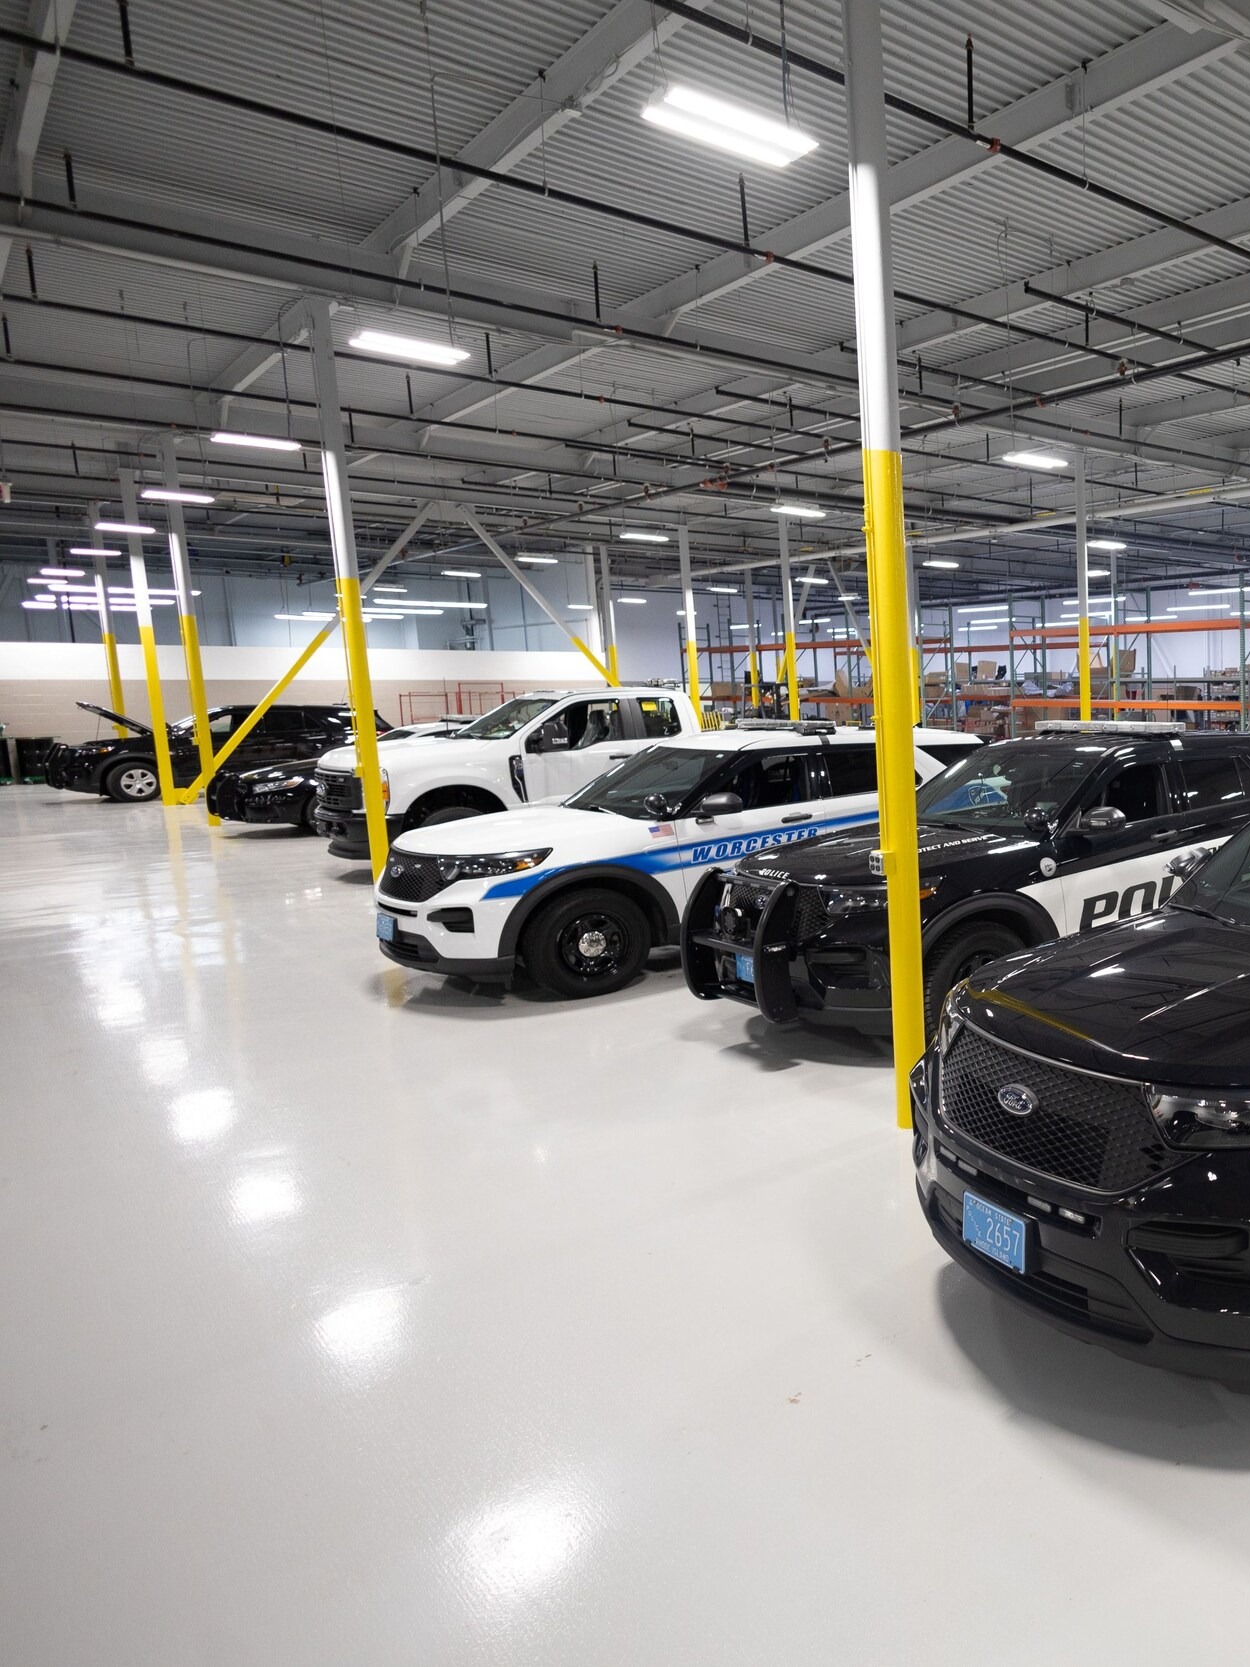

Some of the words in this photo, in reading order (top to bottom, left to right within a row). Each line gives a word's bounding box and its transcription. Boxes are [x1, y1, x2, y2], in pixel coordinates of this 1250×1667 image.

[690, 826, 820, 864] WORCESTER
[917, 844, 942, 854] OTECT
[943, 840, 961, 848] AND
[761, 868, 790, 880] POLICE
[1079, 875, 1175, 932] POL
[994, 1212, 1014, 1226] STATE
[986, 1217, 1020, 1257] 2657
